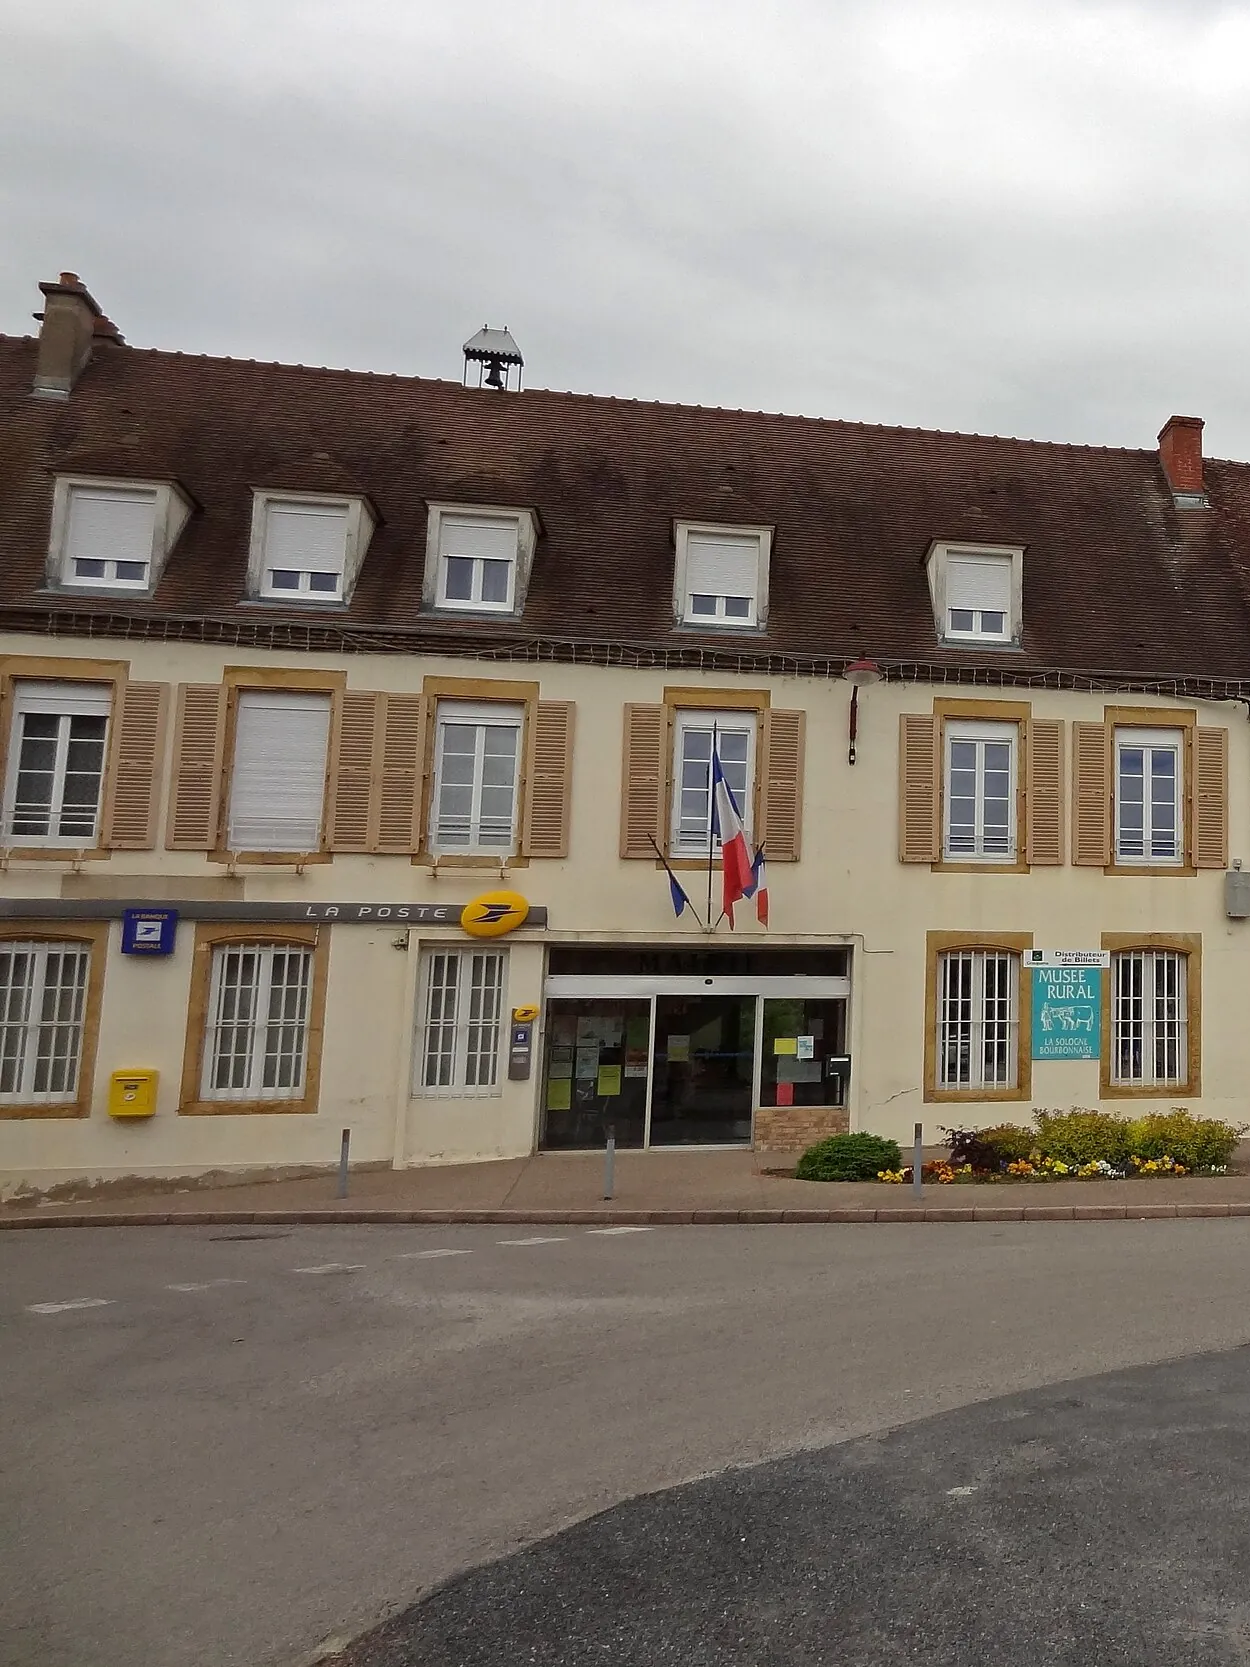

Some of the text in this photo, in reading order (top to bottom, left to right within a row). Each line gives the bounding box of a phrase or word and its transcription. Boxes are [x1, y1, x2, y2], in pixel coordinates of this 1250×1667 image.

[306, 906, 448, 918] LA POSTE
[1038, 969, 1087, 983] MUSEE
[1047, 984, 1095, 999] RURAL
[1044, 1037, 1088, 1046] LA SOLOGNE
[1039, 1046, 1093, 1054] BOURBONNAISE
